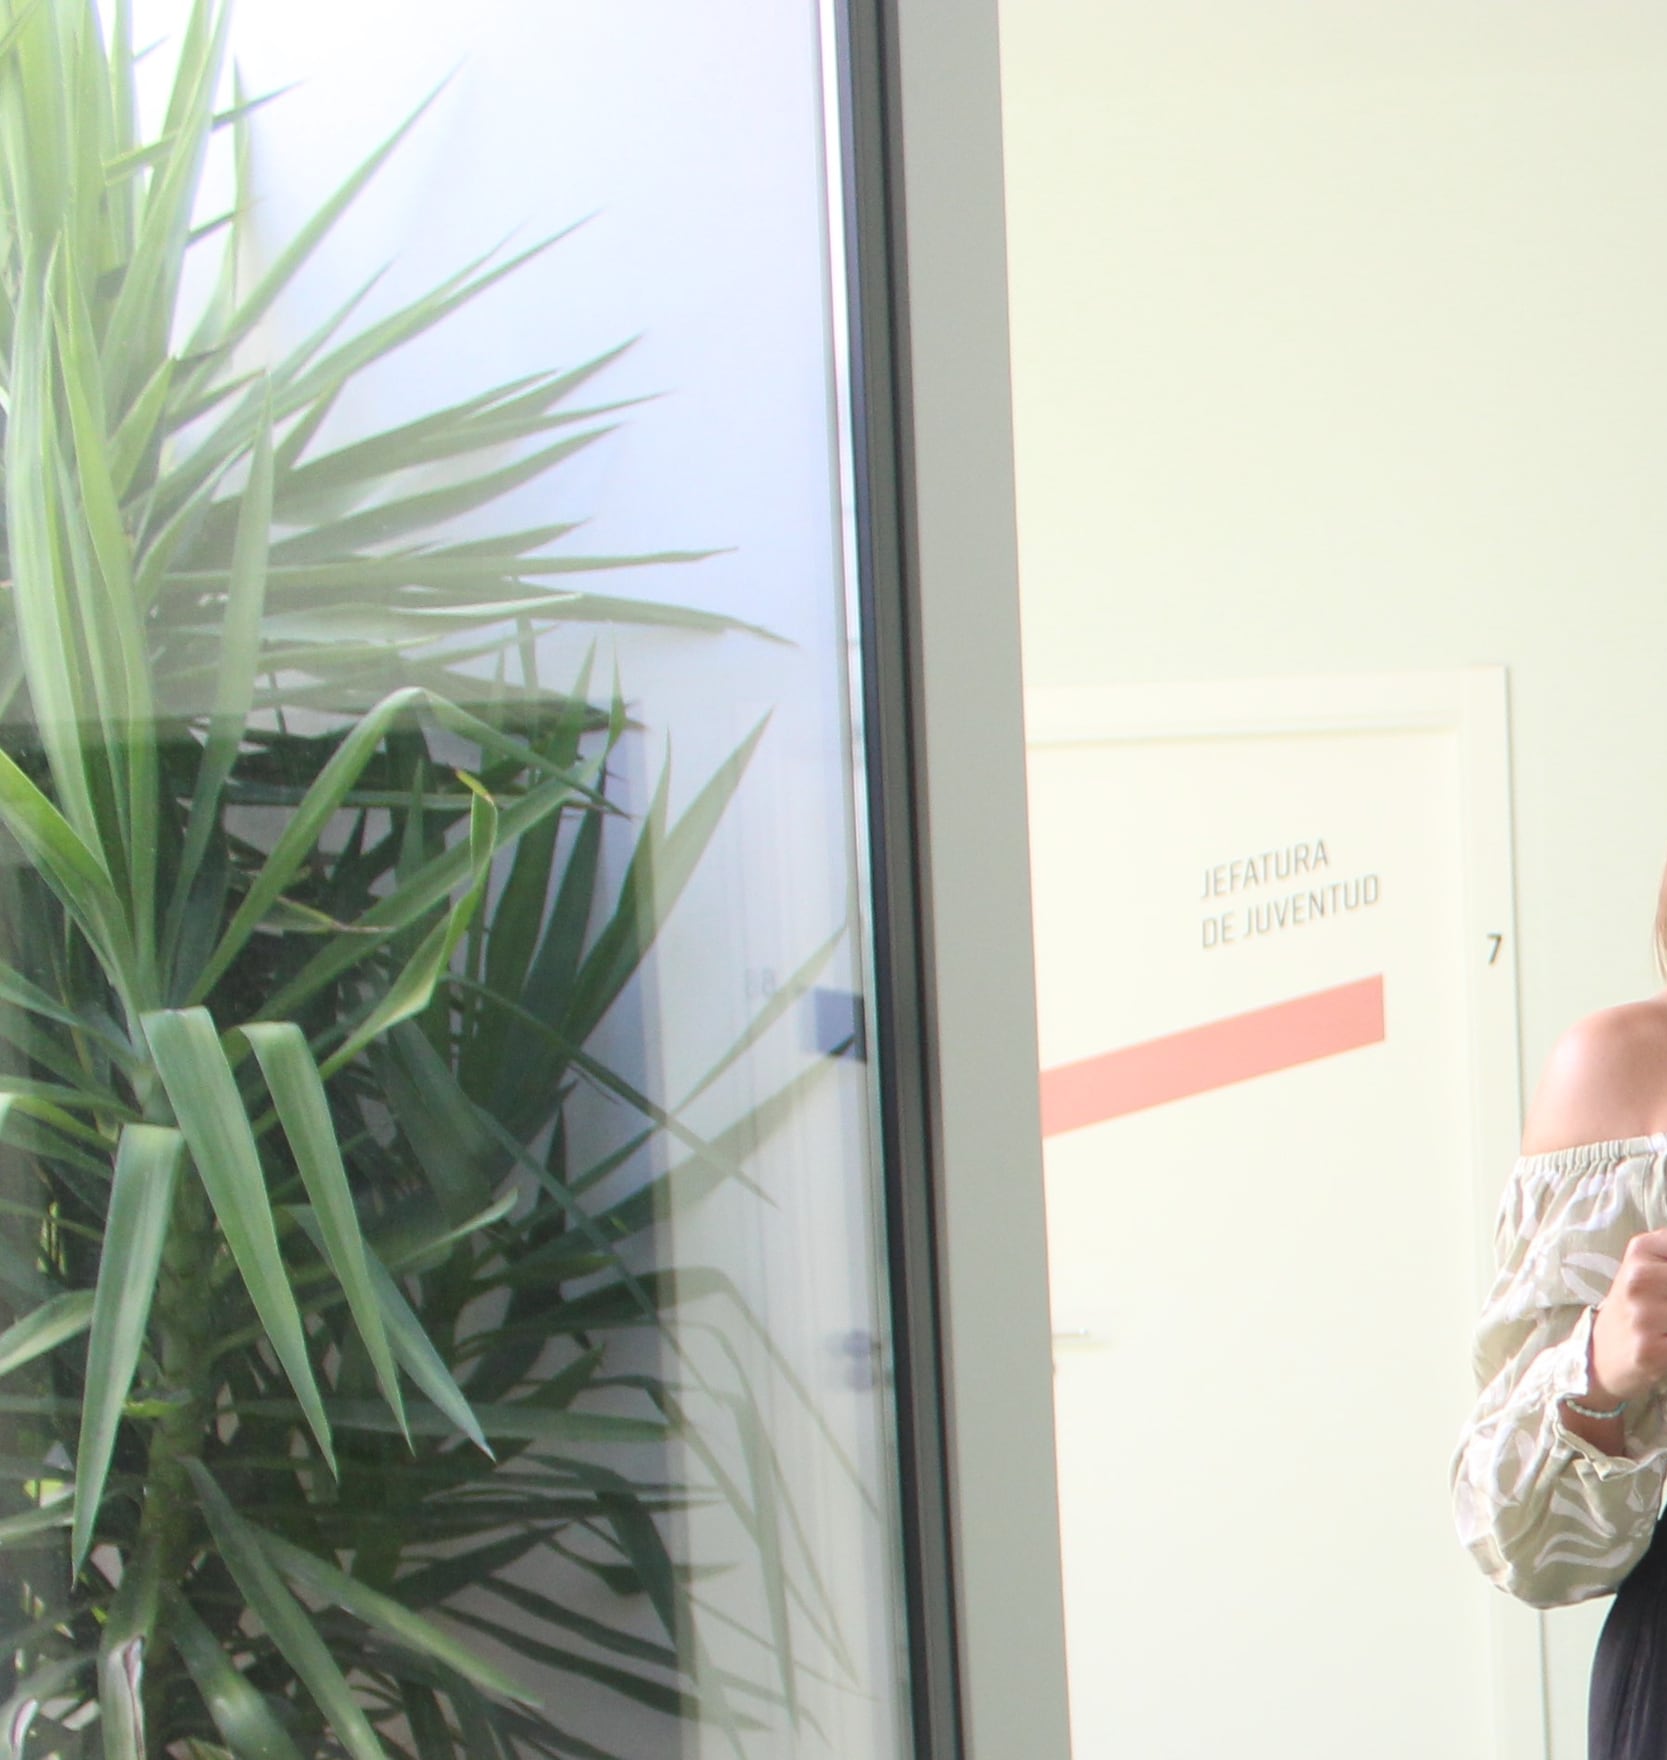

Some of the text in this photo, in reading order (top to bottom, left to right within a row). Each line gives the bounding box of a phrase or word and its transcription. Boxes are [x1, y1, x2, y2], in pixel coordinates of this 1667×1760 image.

[1202, 838, 1329, 899] JEFATURA
[1203, 874, 1379, 949] DE JUVENTUD
[1487, 933, 1503, 966] 7
